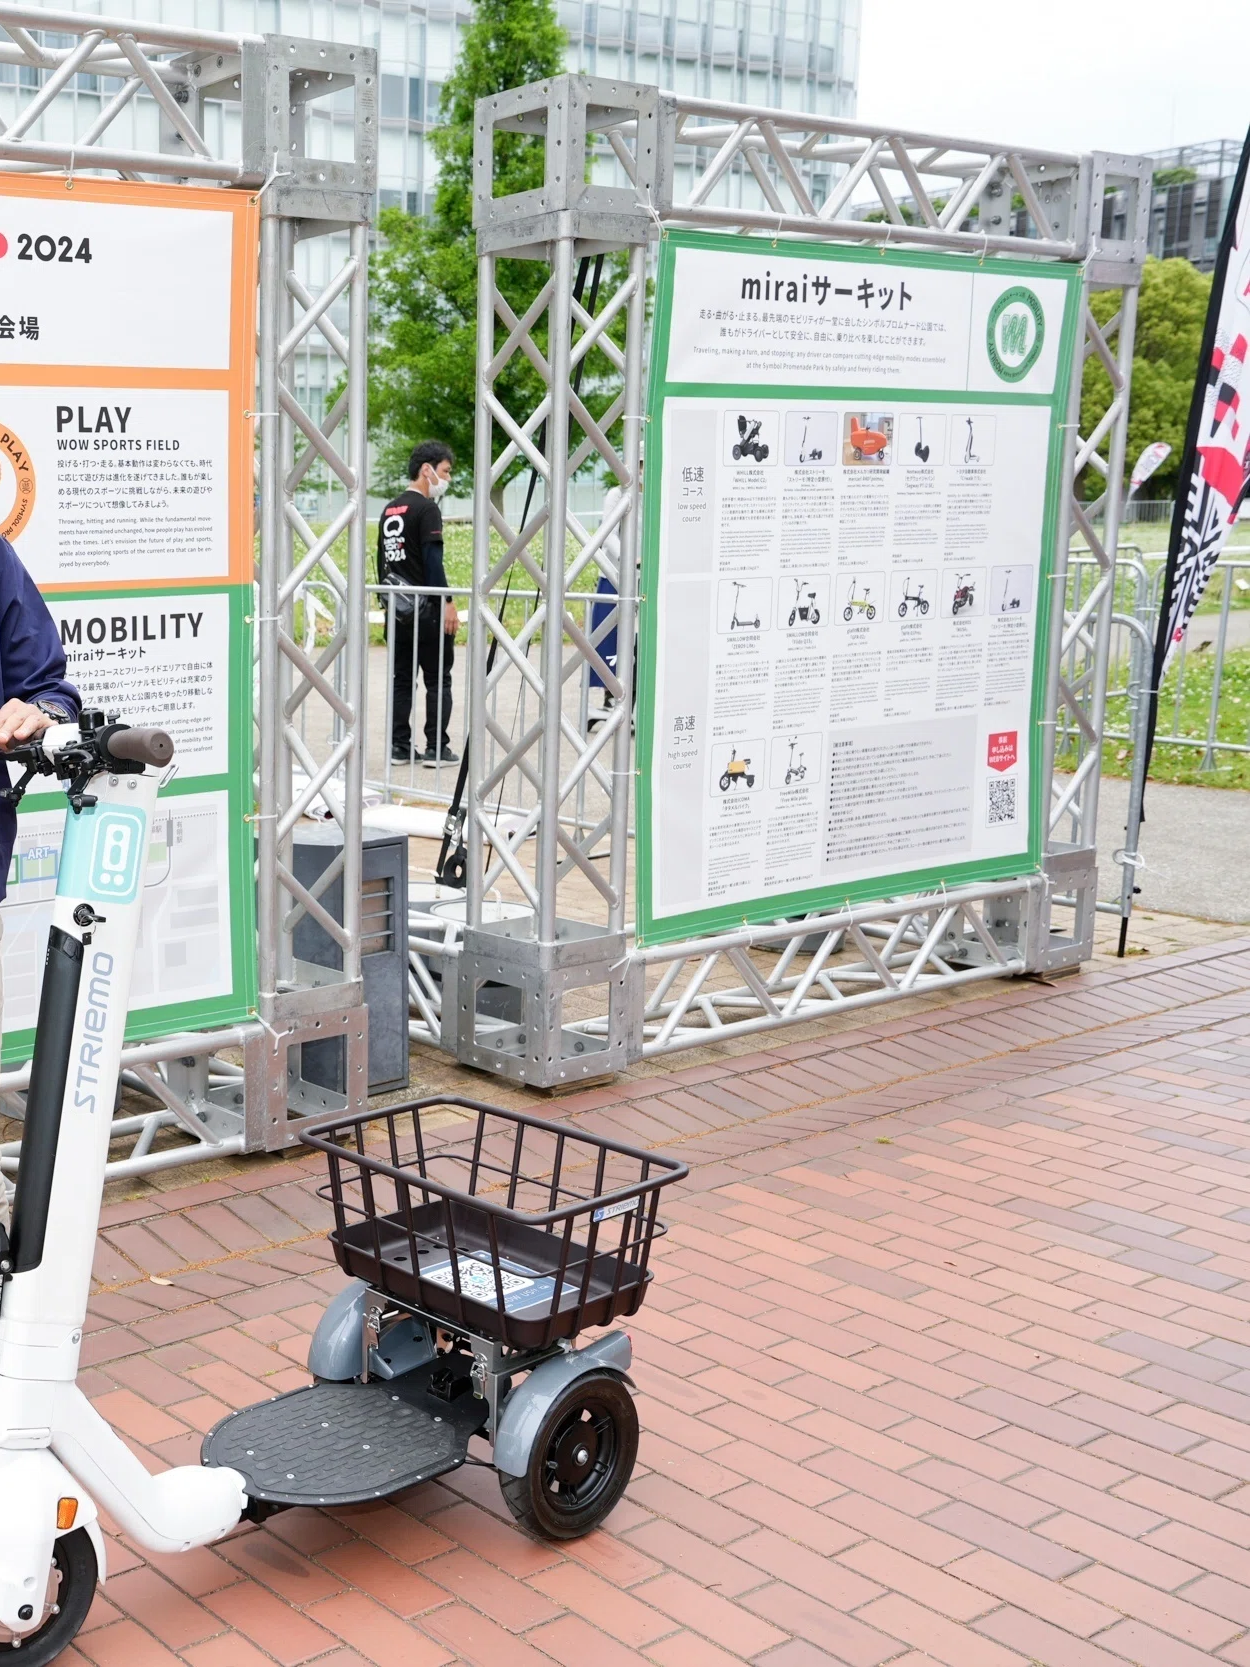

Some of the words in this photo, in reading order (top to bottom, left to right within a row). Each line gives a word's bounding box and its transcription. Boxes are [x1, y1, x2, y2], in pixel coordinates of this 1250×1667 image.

[17, 233, 92, 263] 2024
[56, 405, 132, 433] PLAY
[57, 439, 90, 451] WOW
[93, 439, 142, 451] SPORTS
[146, 439, 180, 451] FIELD
[0, 433, 29, 472] PLAY
[682, 466, 705, 483] 低速
[682, 486, 704, 497] コース
[677, 502, 688, 510] low
[689, 502, 707, 512] speed
[682, 515, 701, 523] course
[60, 612, 204, 646] MOBILITY
[65, 661, 213, 680] ーキット2コースとフリーライドエリアで自由に体
[136, 720, 149, 728] wide
[149, 720, 164, 729] range
[673, 715, 696, 732] 高速
[182, 736, 201, 744] mobility
[673, 734, 694, 745] コース
[667, 750, 680, 759] high
[681, 749, 698, 759] speed
[672, 762, 692, 770] course
[27, 847, 50, 860] ART
